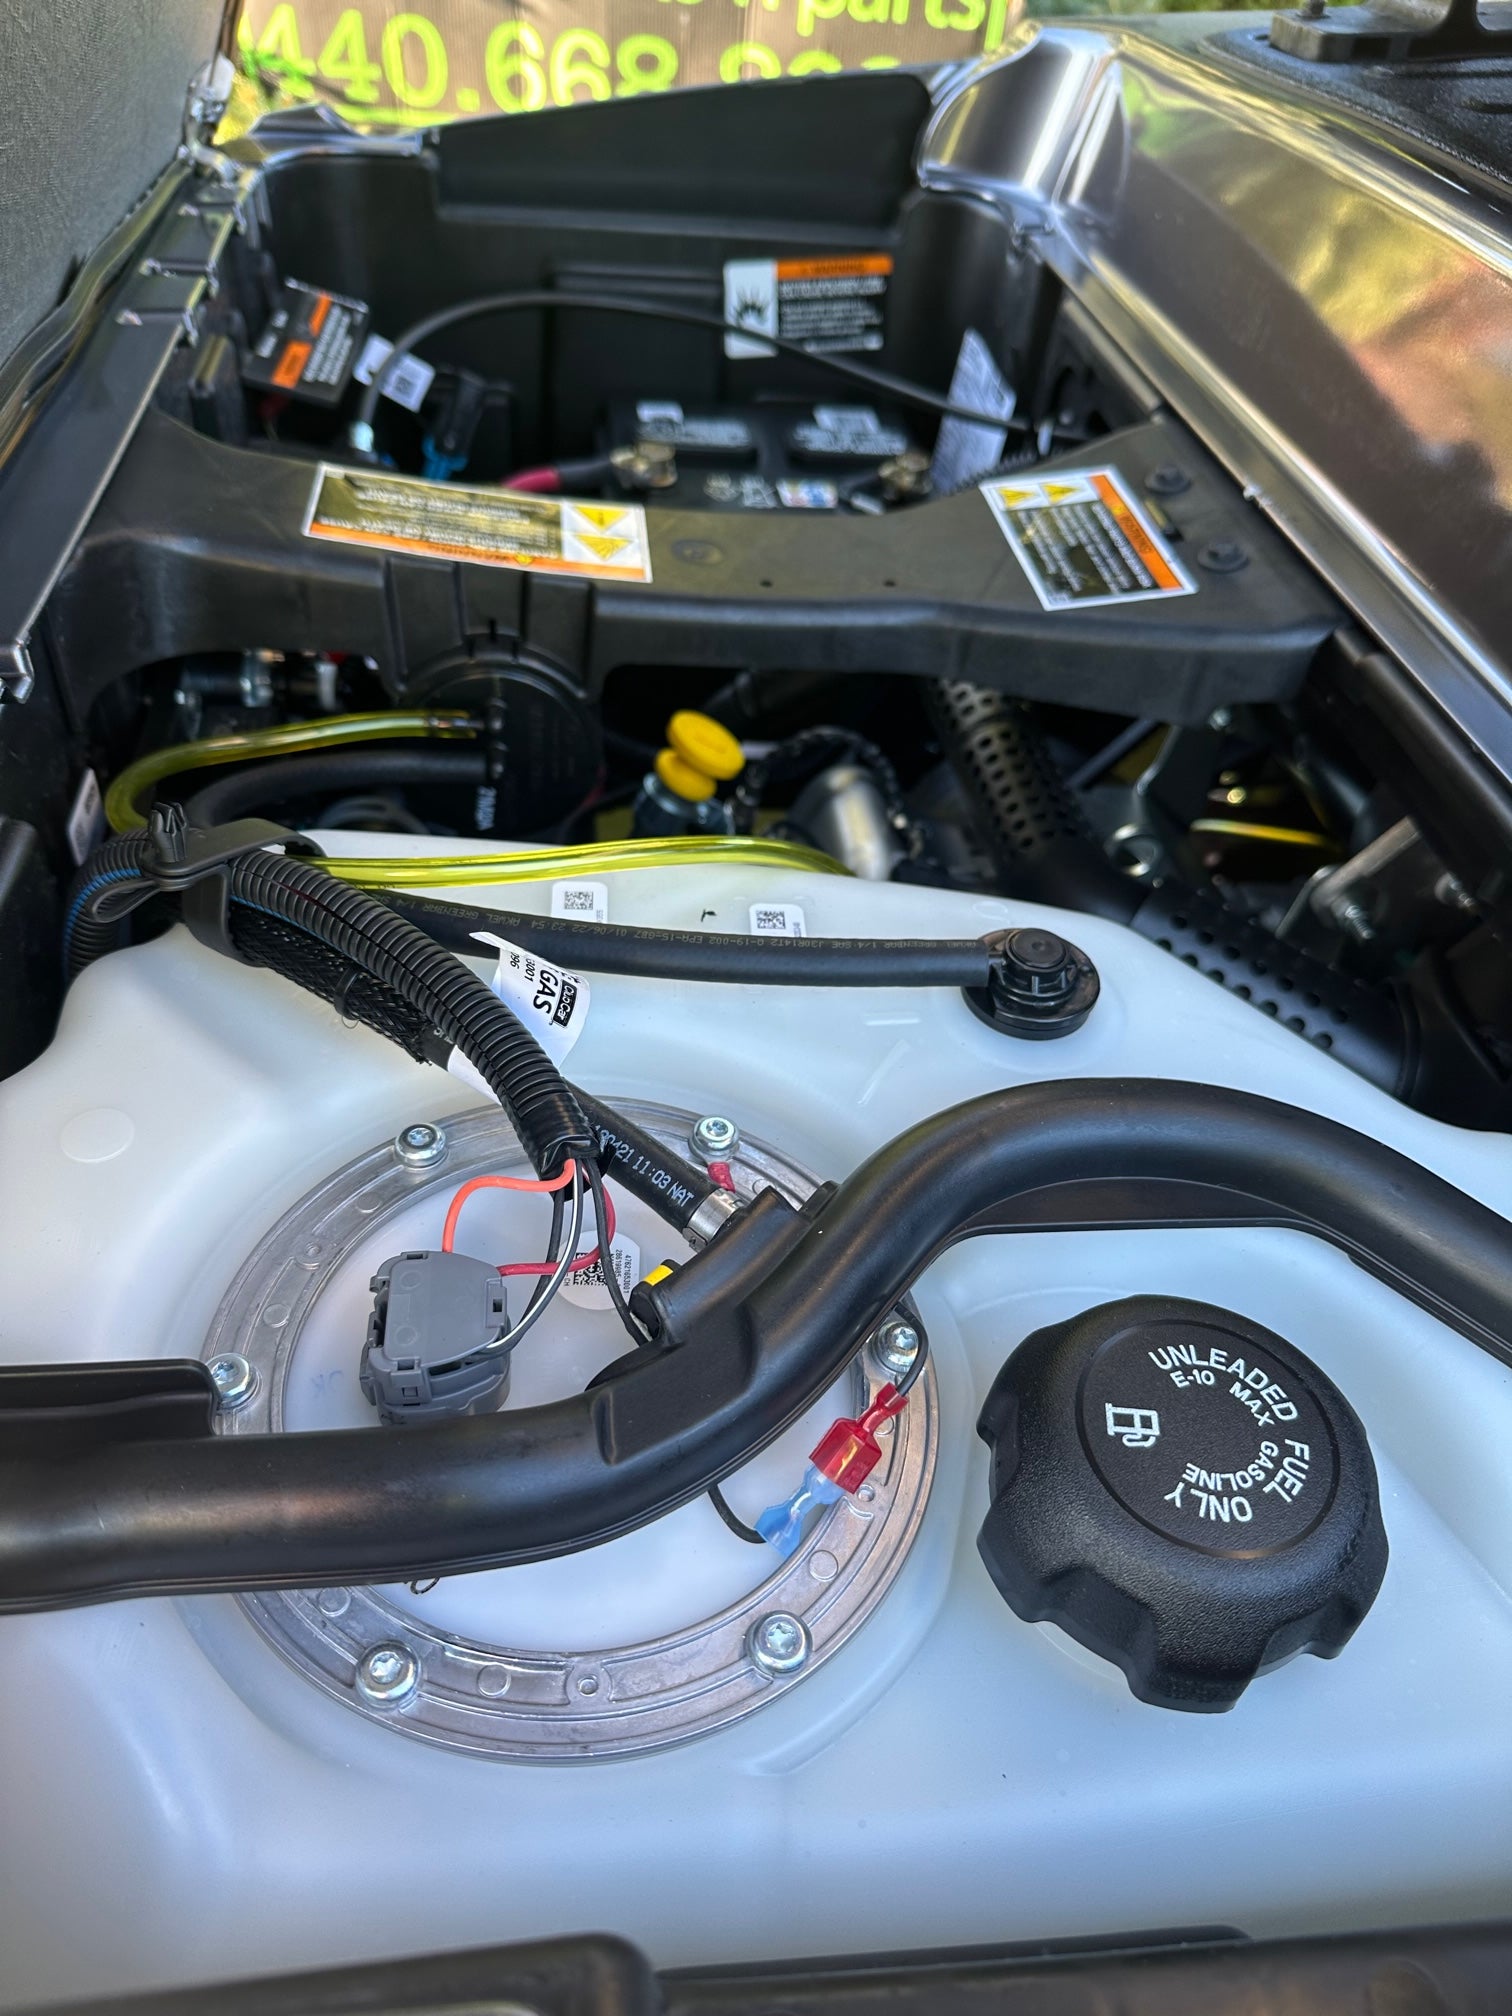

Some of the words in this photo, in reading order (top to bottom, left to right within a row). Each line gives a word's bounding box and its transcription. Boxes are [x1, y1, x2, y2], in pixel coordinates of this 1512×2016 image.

[532, 969, 559, 1015] GAS
[632, 1155, 672, 1190] 11:03
[666, 1180, 695, 1208] NAT
[1147, 1343, 1299, 1421] UNLEADED
[1169, 1369, 1216, 1388] E-10
[1229, 1381, 1276, 1427] MAX
[1182, 1440, 1279, 1491] GASOLINE
[1262, 1438, 1311, 1503] FUEL
[1163, 1482, 1253, 1523] ONLY
